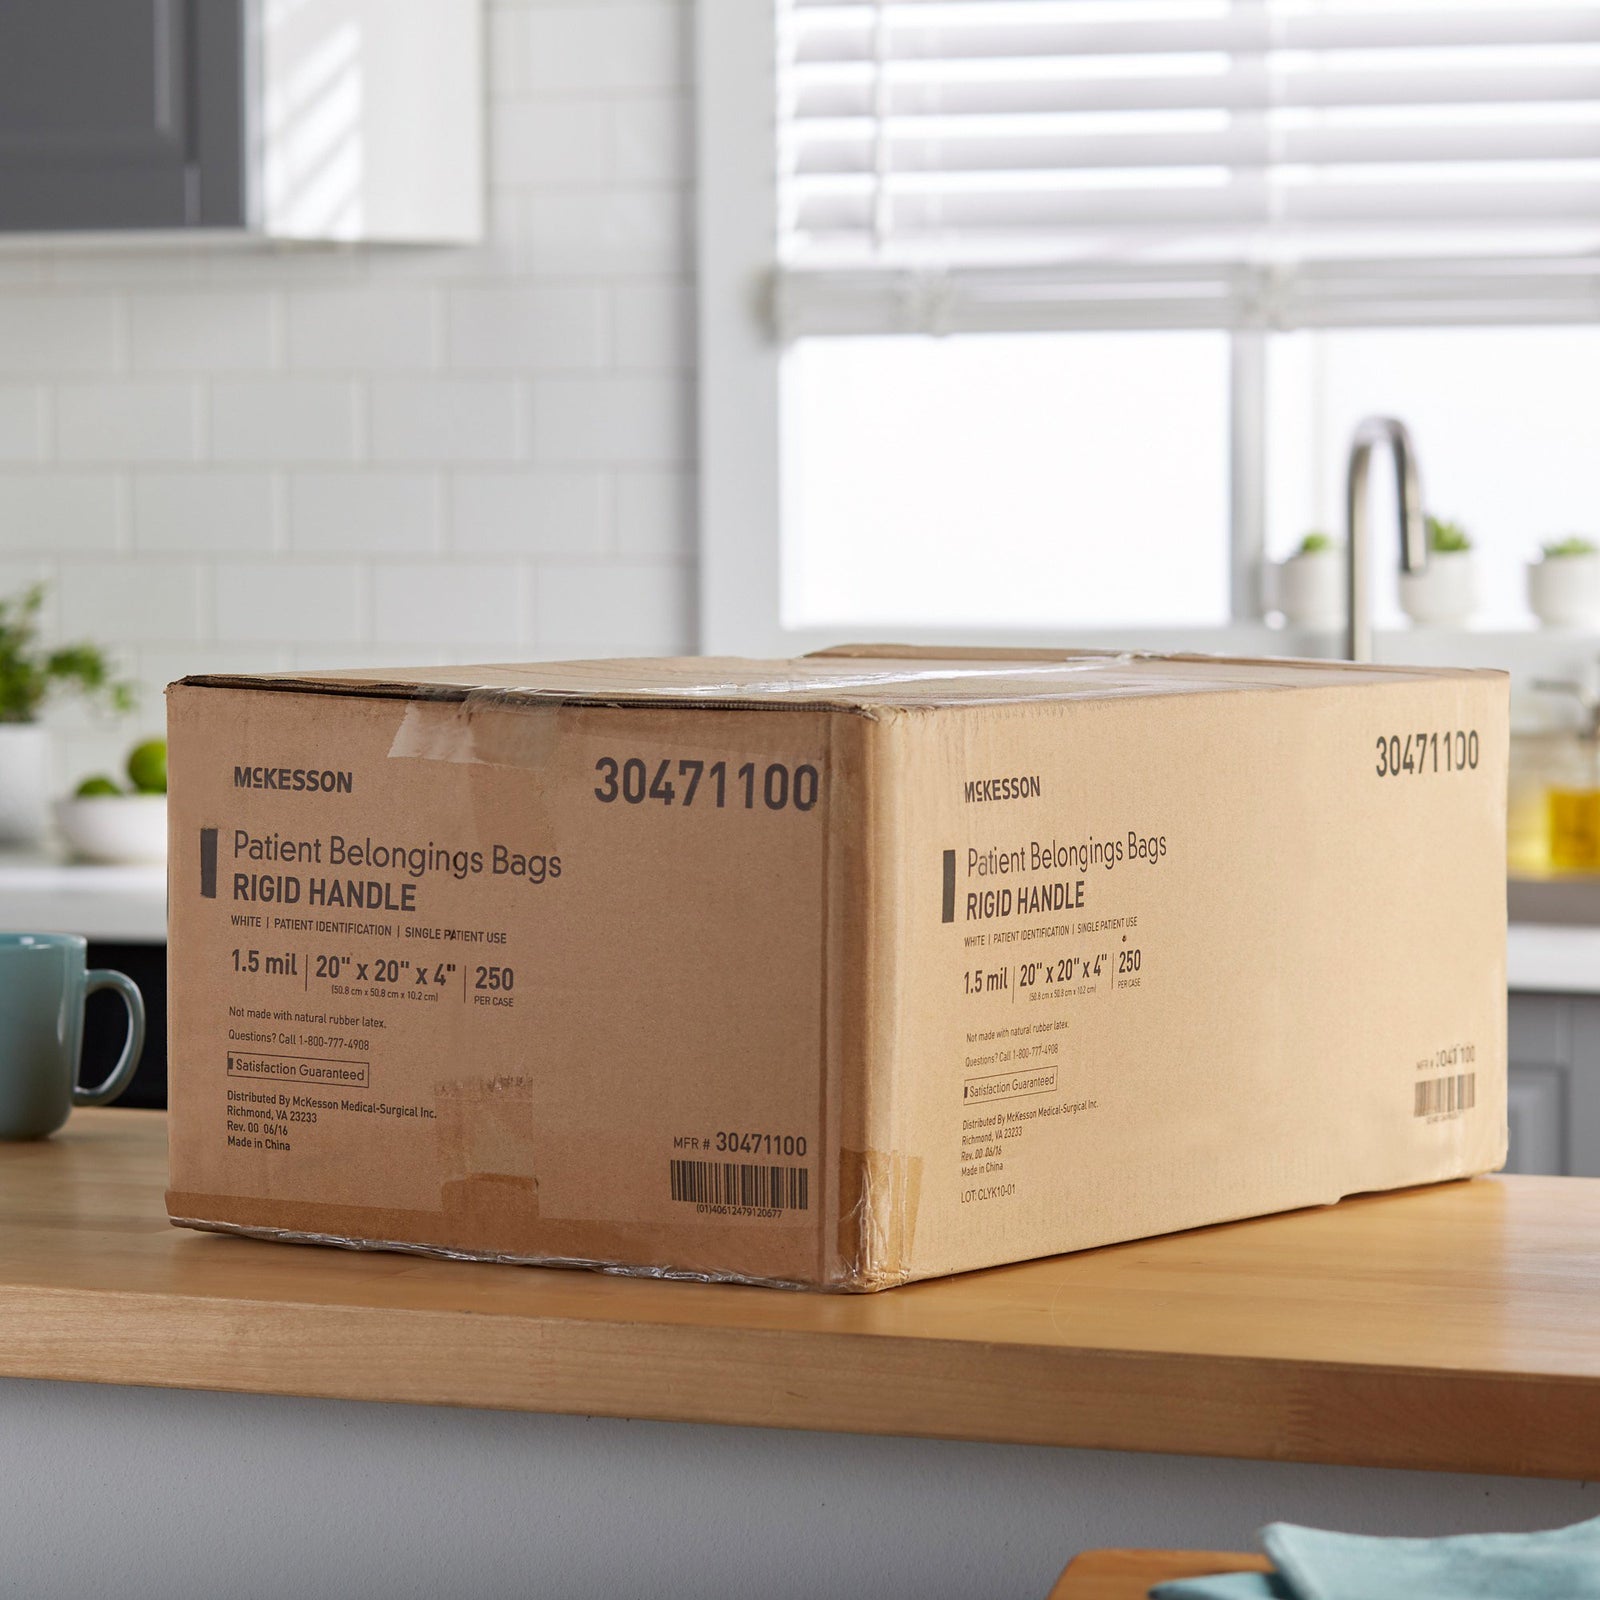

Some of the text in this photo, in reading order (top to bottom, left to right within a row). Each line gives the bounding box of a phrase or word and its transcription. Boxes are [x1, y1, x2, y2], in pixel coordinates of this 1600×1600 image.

[1376, 730, 1479, 777] 30471100
[594, 757, 819, 811] 30471100
[234, 830, 562, 884] Patient Belongings Bags
[968, 831, 1167, 877] Patient Belongings Bags
[233, 873, 416, 911] RIGID HANDLE
[966, 880, 1085, 921] RIGID HANDLE
[231, 914, 507, 944] WHITE PATIENT IDENTIFICATION SINGLE PATIENT USE
[964, 916, 1138, 948] WHITE PATIENT IDENTIFICATION SINGLE PATIENT USE
[232, 949, 514, 991] 1.5 mil 20" x 20" x 4" 250
[964, 949, 1141, 994] 1.5 mil 20" x 20" x 4" 250
[331, 985, 349, 996] (50.8
[352, 988, 363, 996] cm
[370, 988, 386, 998] 50.8
[387, 991, 399, 999] cm
[407, 990, 422, 1000] 10.2
[424, 993, 439, 1002] cm)
[1118, 978, 1141, 989] PER CASE
[474, 995, 514, 1007] PER CASE
[229, 1006, 387, 1029] Not made with natural rubber latex.
[228, 1029, 369, 1051] Questions? Call 1-800-777-4908
[966, 1020, 1069, 1043] Not made with natural rubber latex.
[965, 1043, 1059, 1068] Questions? Call 1-800-777-4908
[236, 1058, 365, 1082] Satisfaction Guaranteed
[969, 1073, 1055, 1098] Satisfaction Guaranteed
[227, 1090, 437, 1119] Distributed By McKesson Medical-Surgical Inc.
[227, 1105, 317, 1123] Richmond, VA 23233
[962, 1100, 1099, 1131] Distributed By McKesson Medical-Surgical Inc.
[227, 1121, 288, 1136] Rev. 00 06/16
[962, 1126, 1023, 1146] Richmond, VA 23233
[227, 1136, 291, 1151] Made in China
[673, 1131, 807, 1157] MFR # 30471100
[961, 1151, 974, 1162] Rev.
[961, 1162, 1003, 1176] Made in China
[696, 1205, 783, 1219] (01)40612479120677
